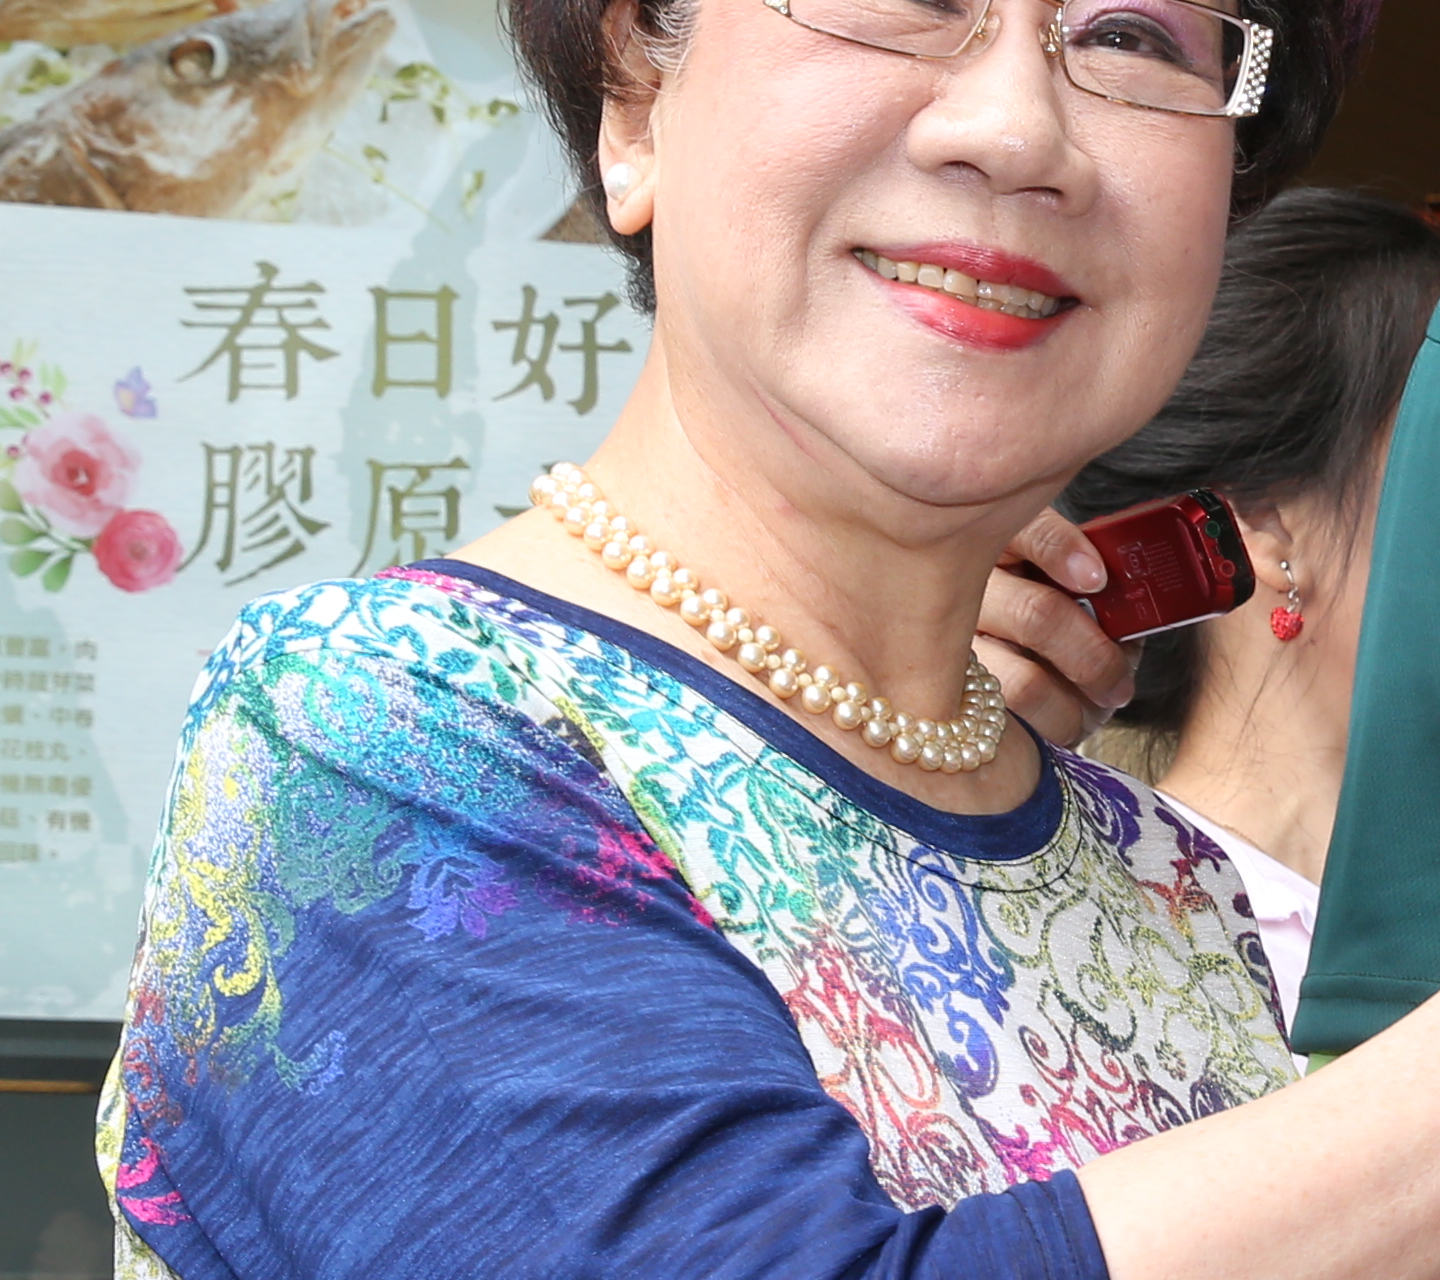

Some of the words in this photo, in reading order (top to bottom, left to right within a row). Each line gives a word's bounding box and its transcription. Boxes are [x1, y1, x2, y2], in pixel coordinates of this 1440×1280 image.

[177, 261, 634, 416] 春日好
[173, 440, 570, 588] 膠原
